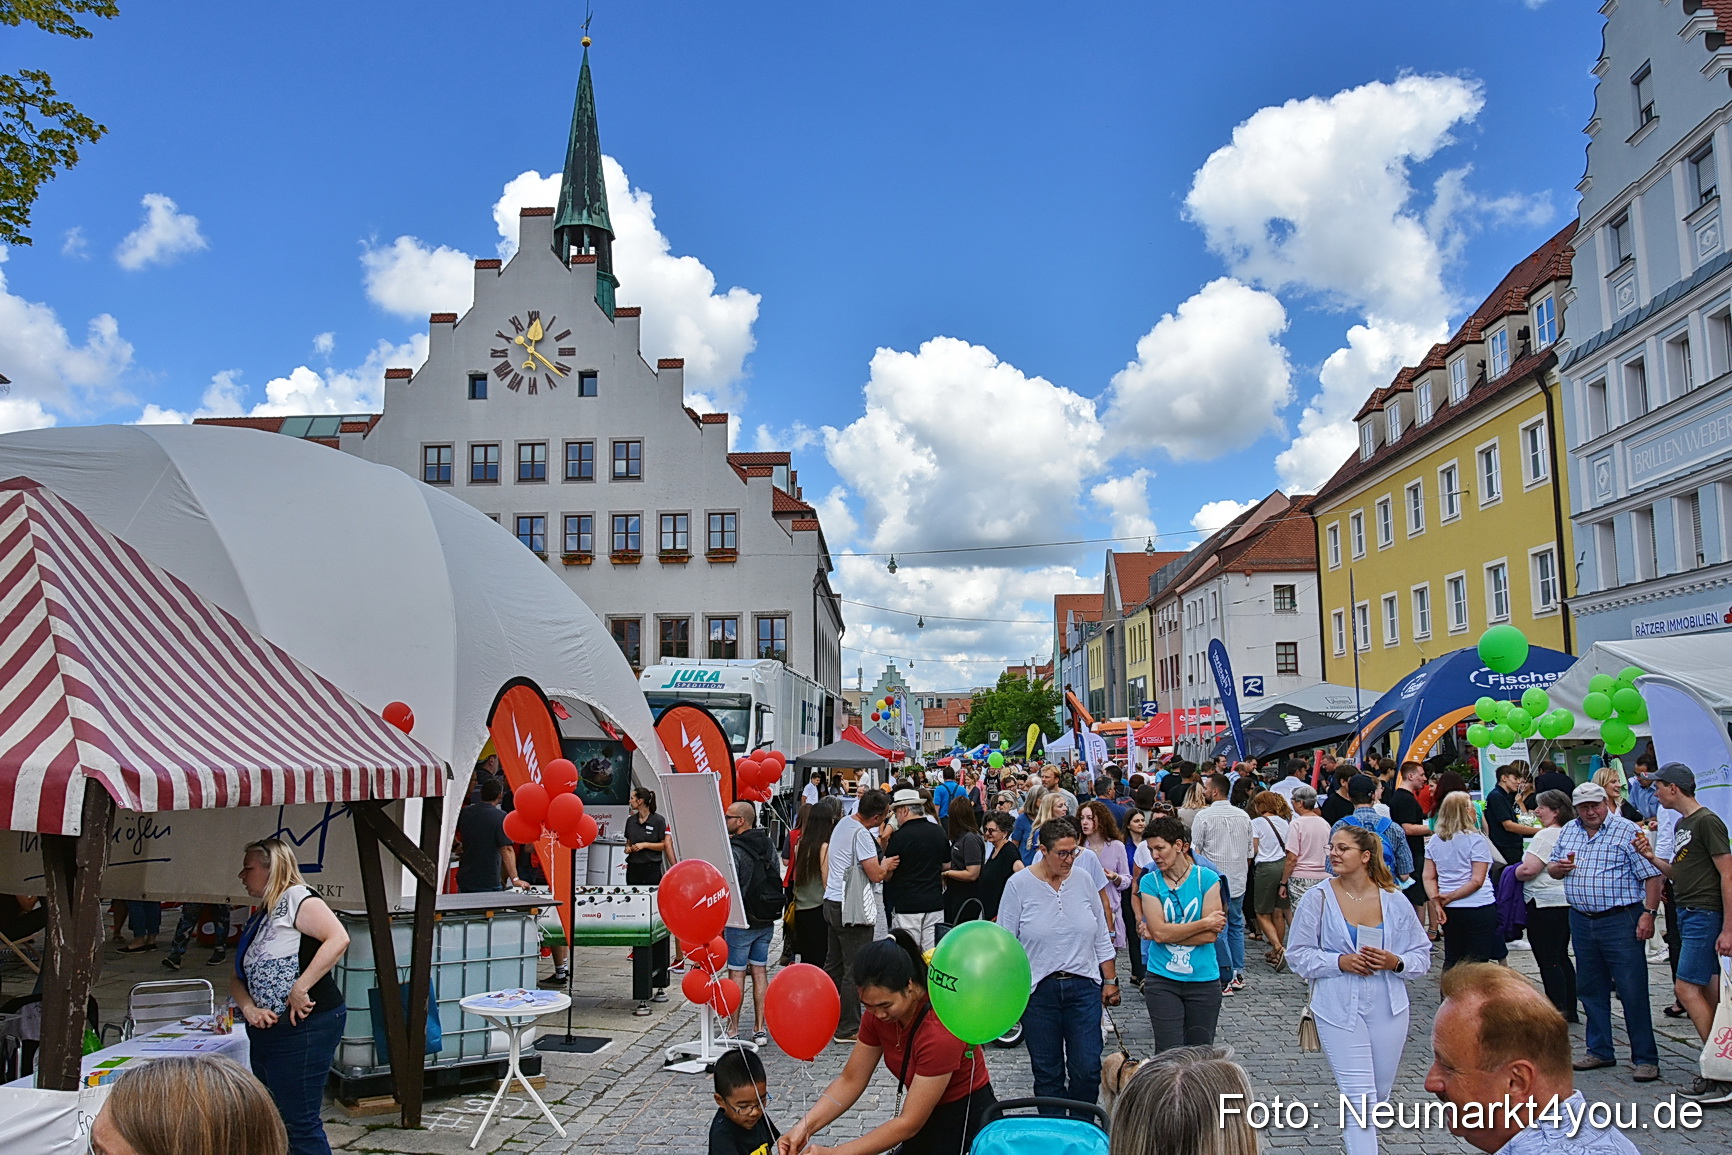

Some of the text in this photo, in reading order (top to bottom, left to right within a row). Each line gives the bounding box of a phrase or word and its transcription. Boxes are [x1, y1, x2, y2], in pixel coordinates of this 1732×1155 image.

[1634, 438, 1683, 475] BRILLEN
[1635, 611, 1719, 637] RÄTZER IMMOBILIEN
[661, 669, 722, 689] JURA
[1488, 671, 1564, 685] Fischer
[317, 885, 344, 898] RKT
[706, 887, 726, 908] DEHN
